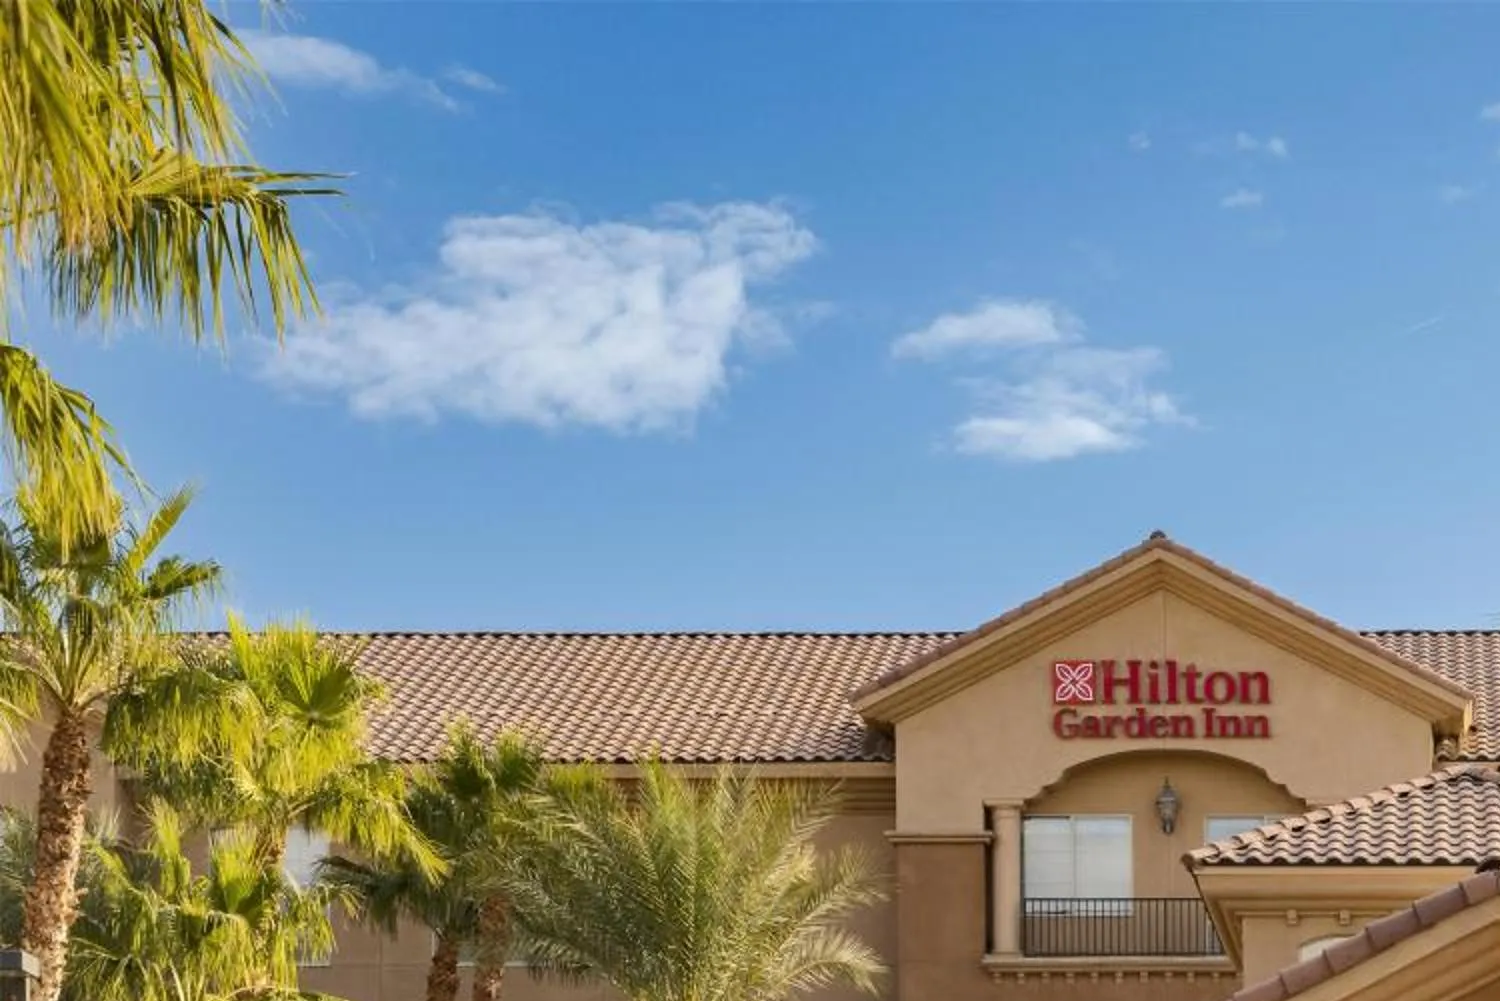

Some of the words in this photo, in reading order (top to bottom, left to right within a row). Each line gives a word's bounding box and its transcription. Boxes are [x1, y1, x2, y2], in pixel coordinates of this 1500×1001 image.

[1101, 660, 1270, 705] Hilton
[1052, 708, 1196, 739] Garden
[1202, 708, 1270, 738] Inn
